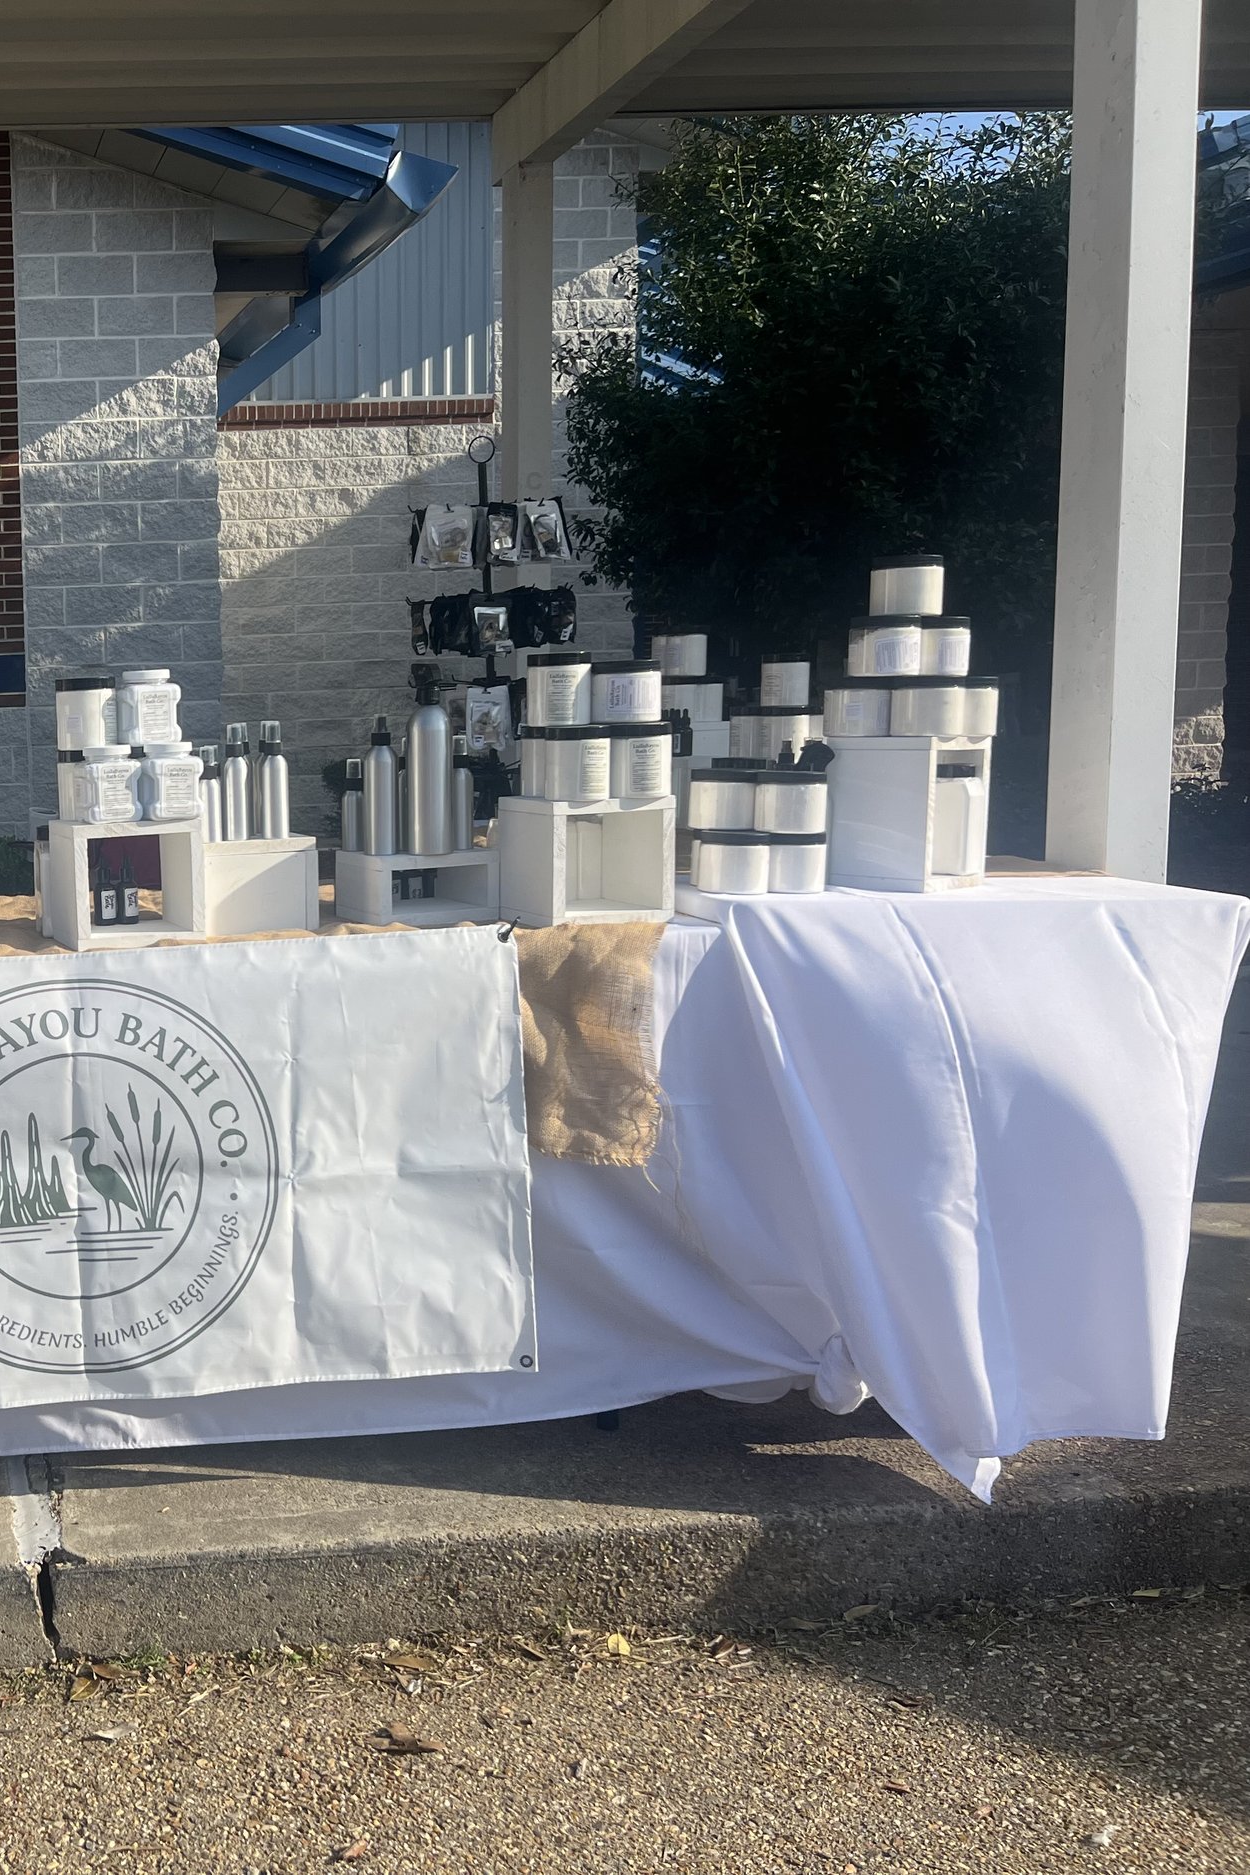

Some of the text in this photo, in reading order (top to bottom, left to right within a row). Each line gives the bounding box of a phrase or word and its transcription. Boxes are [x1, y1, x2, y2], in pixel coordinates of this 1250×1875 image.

[526, 471, 542, 490] C
[115, 1013, 220, 1097] BATH
[209, 1100, 248, 1168] CO.
[94, 1310, 169, 1347] HUMBLE
[168, 1211, 240, 1316] BEGINNINGS.
